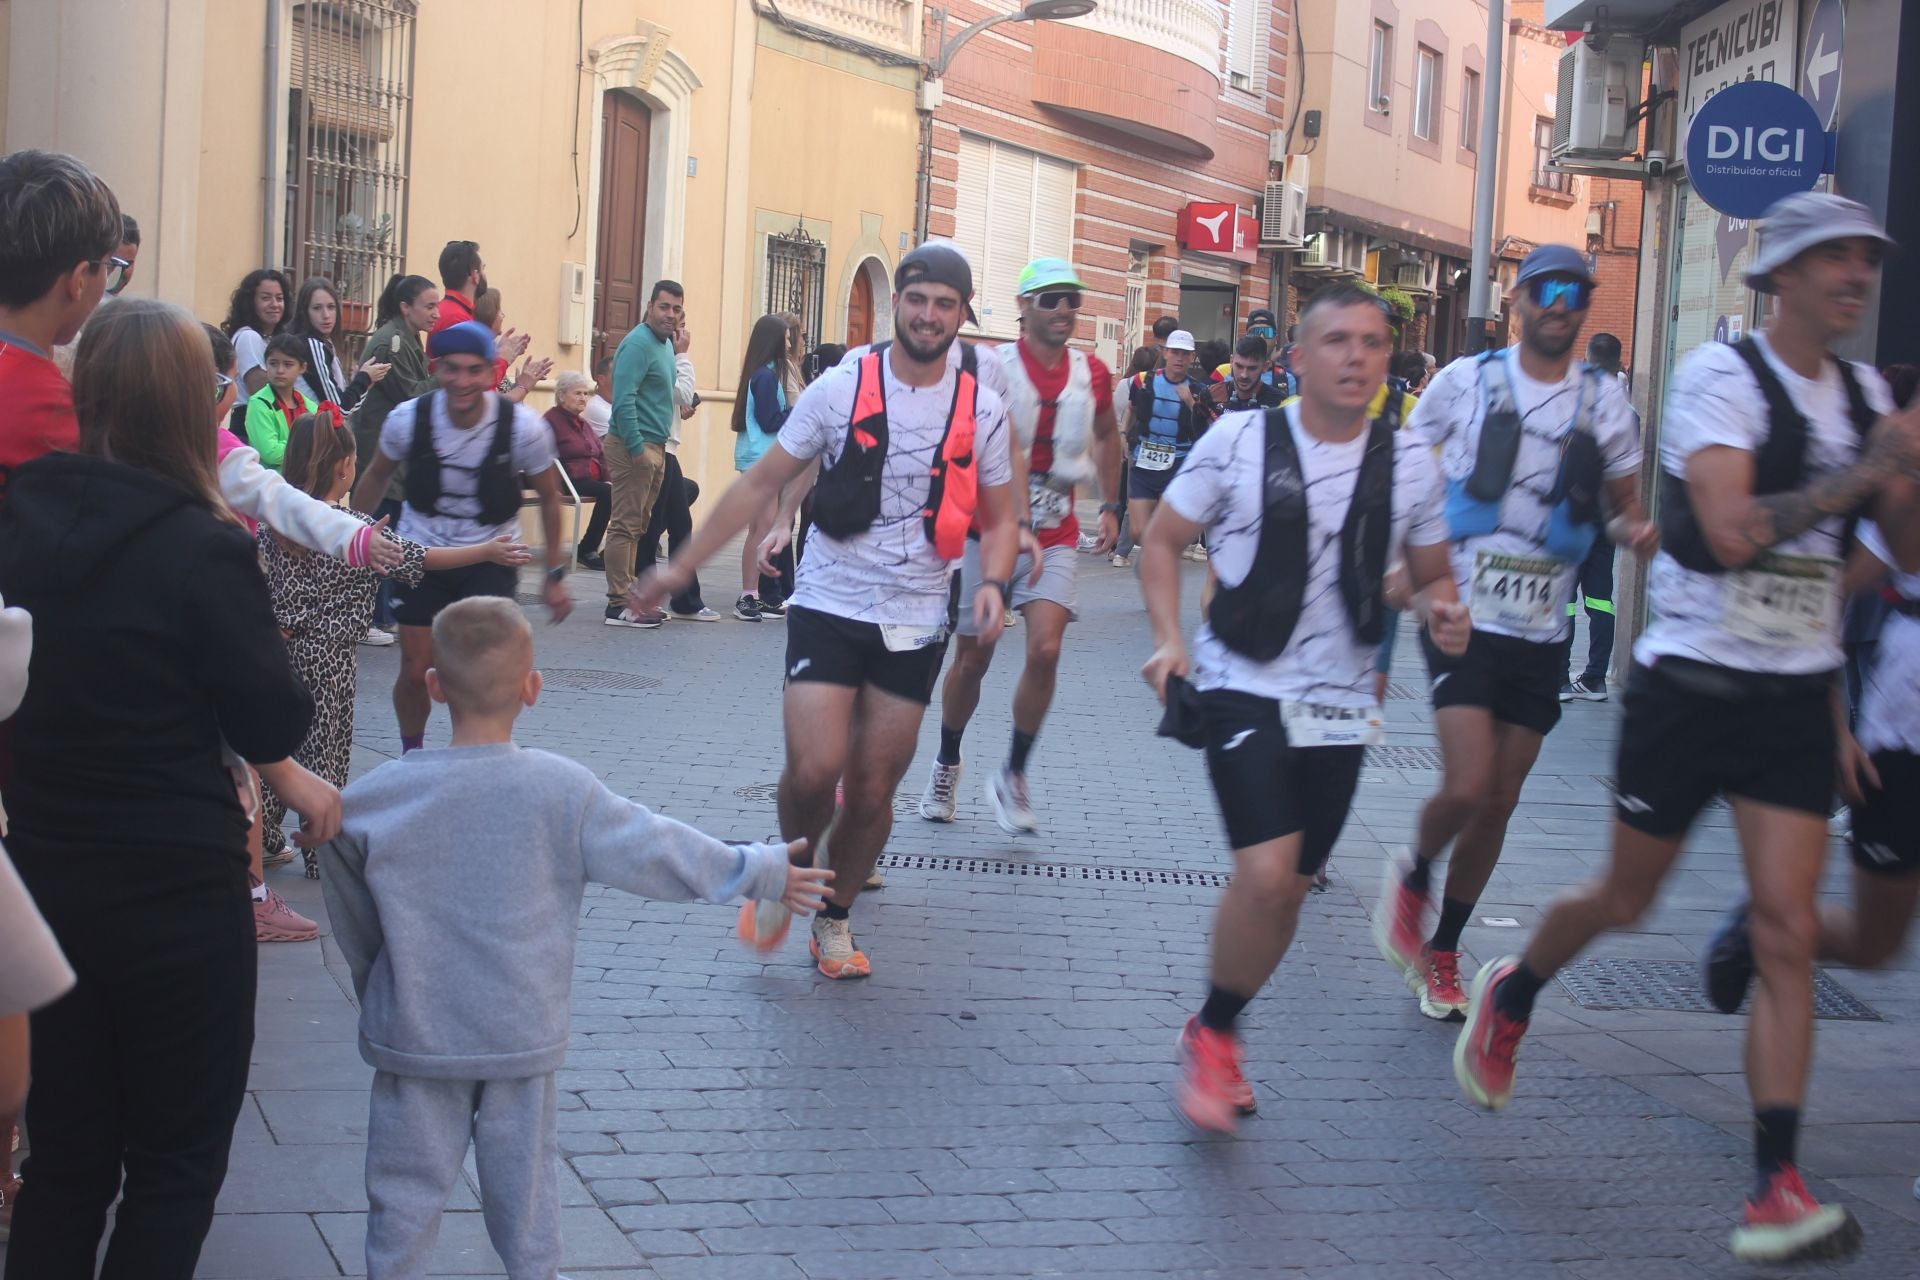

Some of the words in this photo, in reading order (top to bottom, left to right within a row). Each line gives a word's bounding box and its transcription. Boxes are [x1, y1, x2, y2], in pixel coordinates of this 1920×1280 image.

[1707, 125, 1804, 162] DIGI
[1706, 164, 1766, 176] Distribuidor
[1768, 167, 1802, 177] oficial
[1147, 451, 1170, 463] 4212
[1492, 573, 1552, 603] 4114
